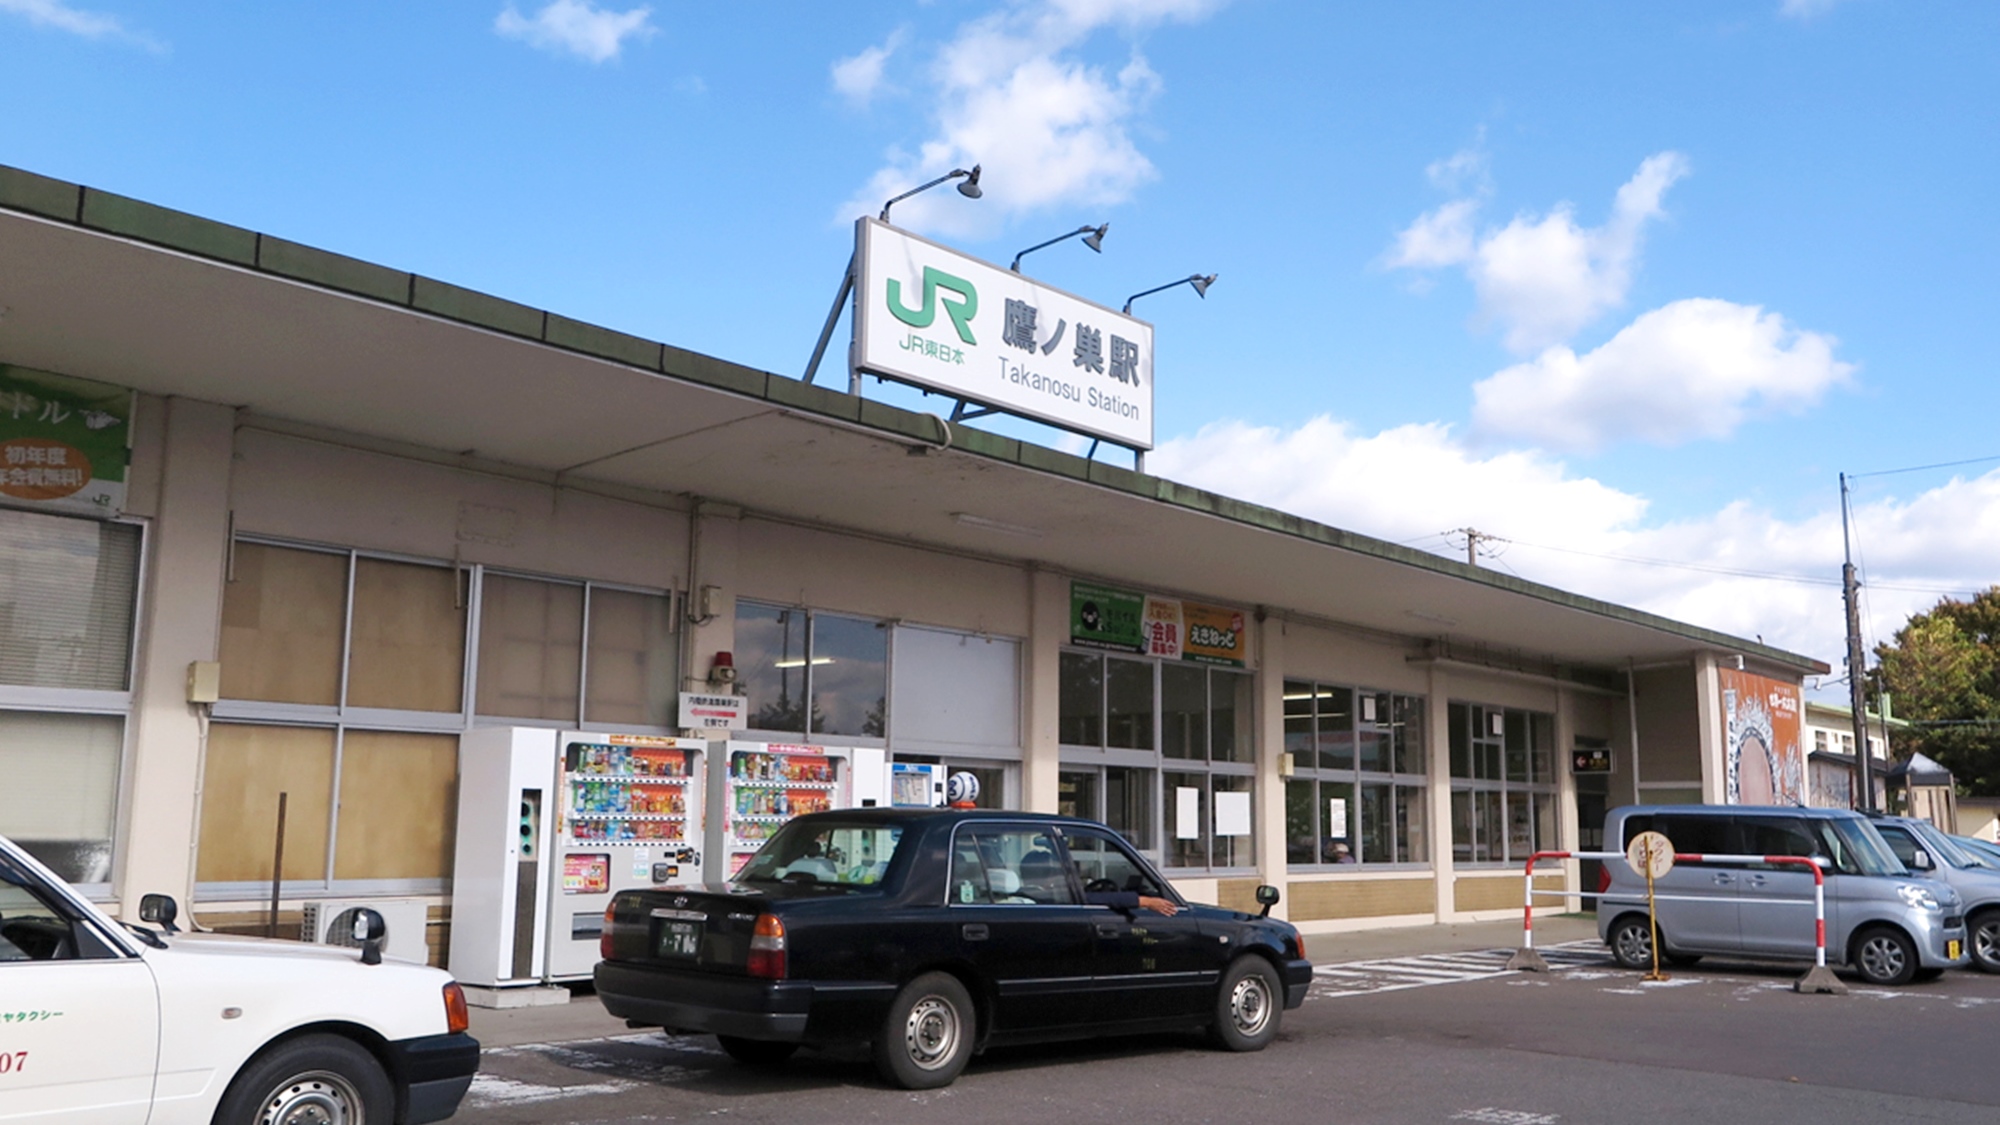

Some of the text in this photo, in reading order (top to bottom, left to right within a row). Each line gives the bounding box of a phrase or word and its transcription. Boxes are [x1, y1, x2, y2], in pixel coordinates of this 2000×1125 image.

[887, 265, 978, 346] JR
[899, 333, 965, 366] JR東日本
[1002, 297, 1140, 388] 鷹ノ巣駅
[998, 356, 1140, 421] Takanosu Station
[5, 445, 67, 465] 初年度
[1152, 621, 1177, 644] 会員
[1190, 625, 1236, 649] えきねっと
[0, 1010, 64, 1023] ヤタクシー
